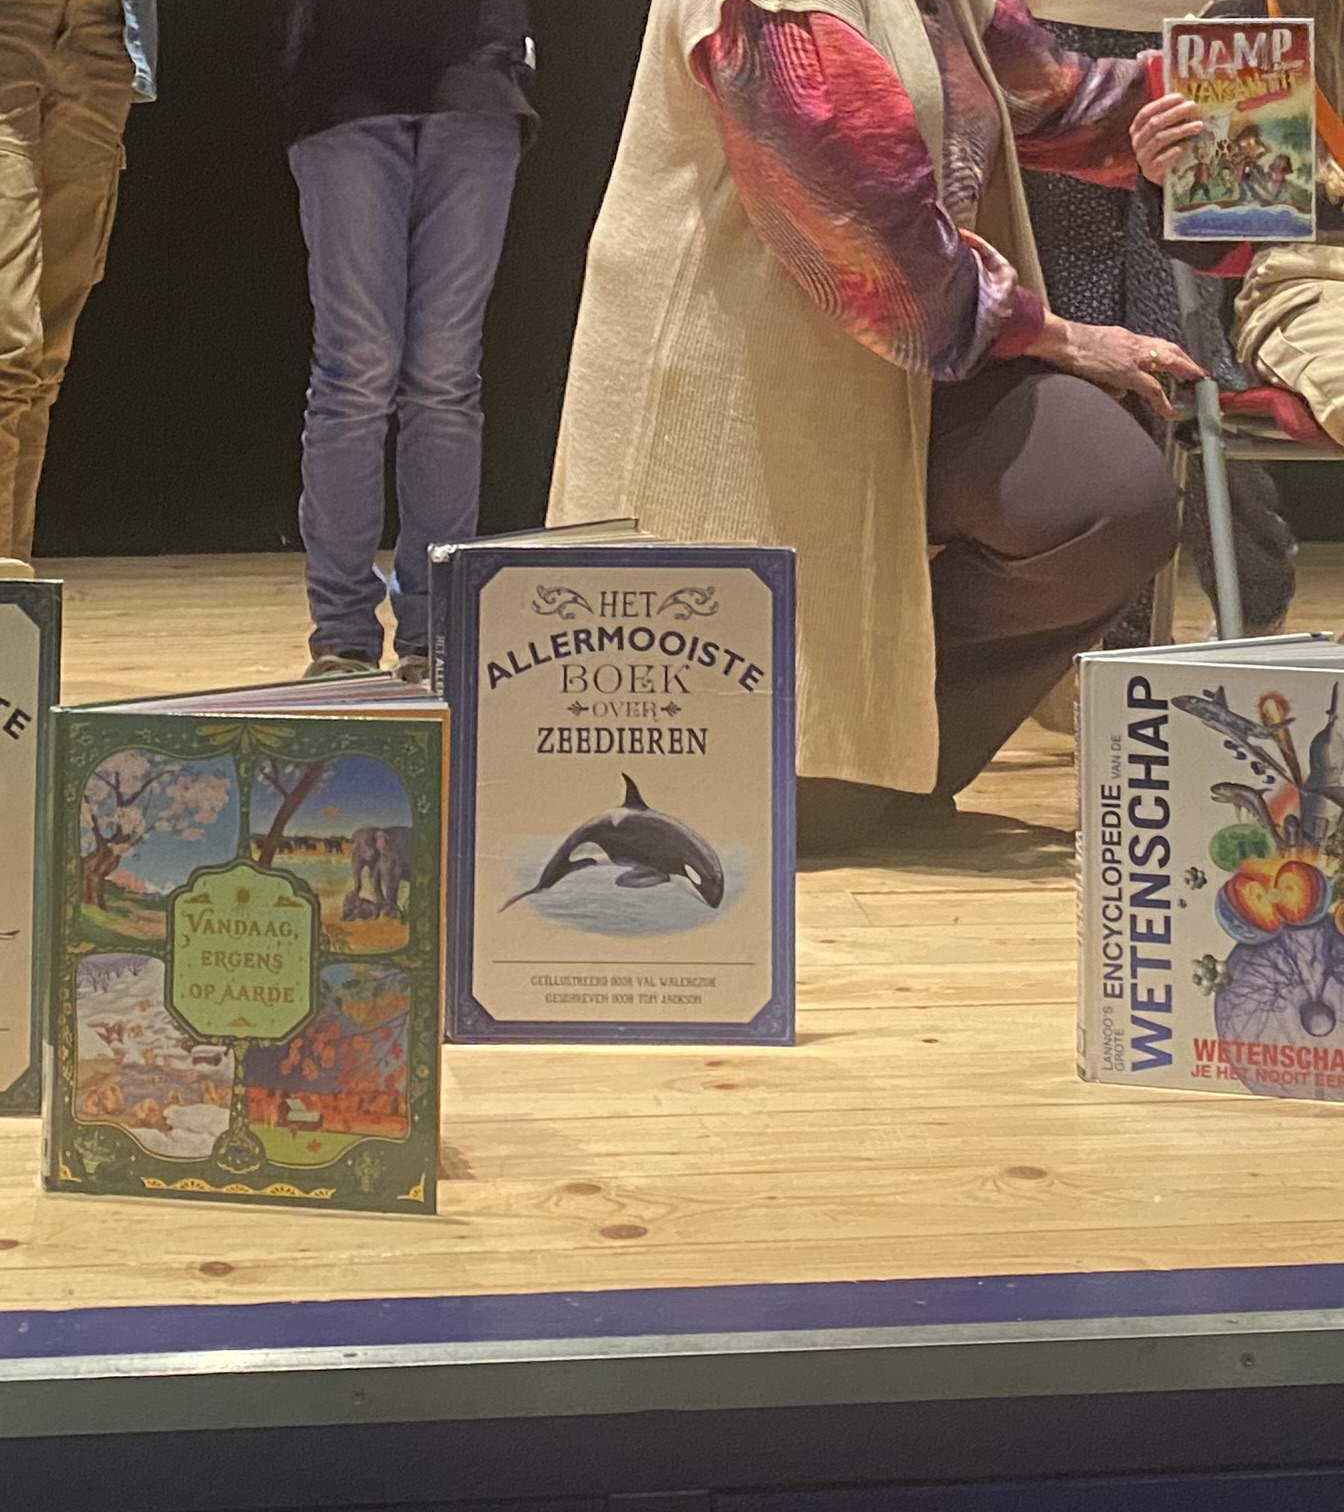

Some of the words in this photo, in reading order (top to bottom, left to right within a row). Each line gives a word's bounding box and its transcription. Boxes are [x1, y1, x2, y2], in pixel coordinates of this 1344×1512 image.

[1177, 28, 1293, 79] RAMP
[599, 590, 657, 618] HET
[486, 626, 765, 692] ALLERMOOISTE
[560, 663, 692, 694] BOEK
[592, 701, 659, 721] OVER
[537, 727, 708, 755] ZEEDIEREN
[1110, 735, 1122, 752] DE
[1111, 755, 1122, 780] VAN
[1127, 675, 1173, 1072] WETENSCHAP
[1101, 784, 1124, 999] ENCYCLOPEDIE
[182, 908, 299, 940] VANDAAG,
[201, 951, 283, 974] ERGENS
[189, 983, 216, 999] OP
[215, 985, 295, 1007] AARDE
[636, 976, 656, 987] VAL
[637, 994, 657, 1005] TOM
[660, 993, 702, 1005] JACKSON
[1102, 1006, 1114, 1071] LANNOO'S
[1114, 1028, 1125, 1073] GROTE
[1191, 1063, 1213, 1080] JE
[1216, 1065, 1249, 1082] HET
[1255, 1069, 1311, 1086] NOOIT
